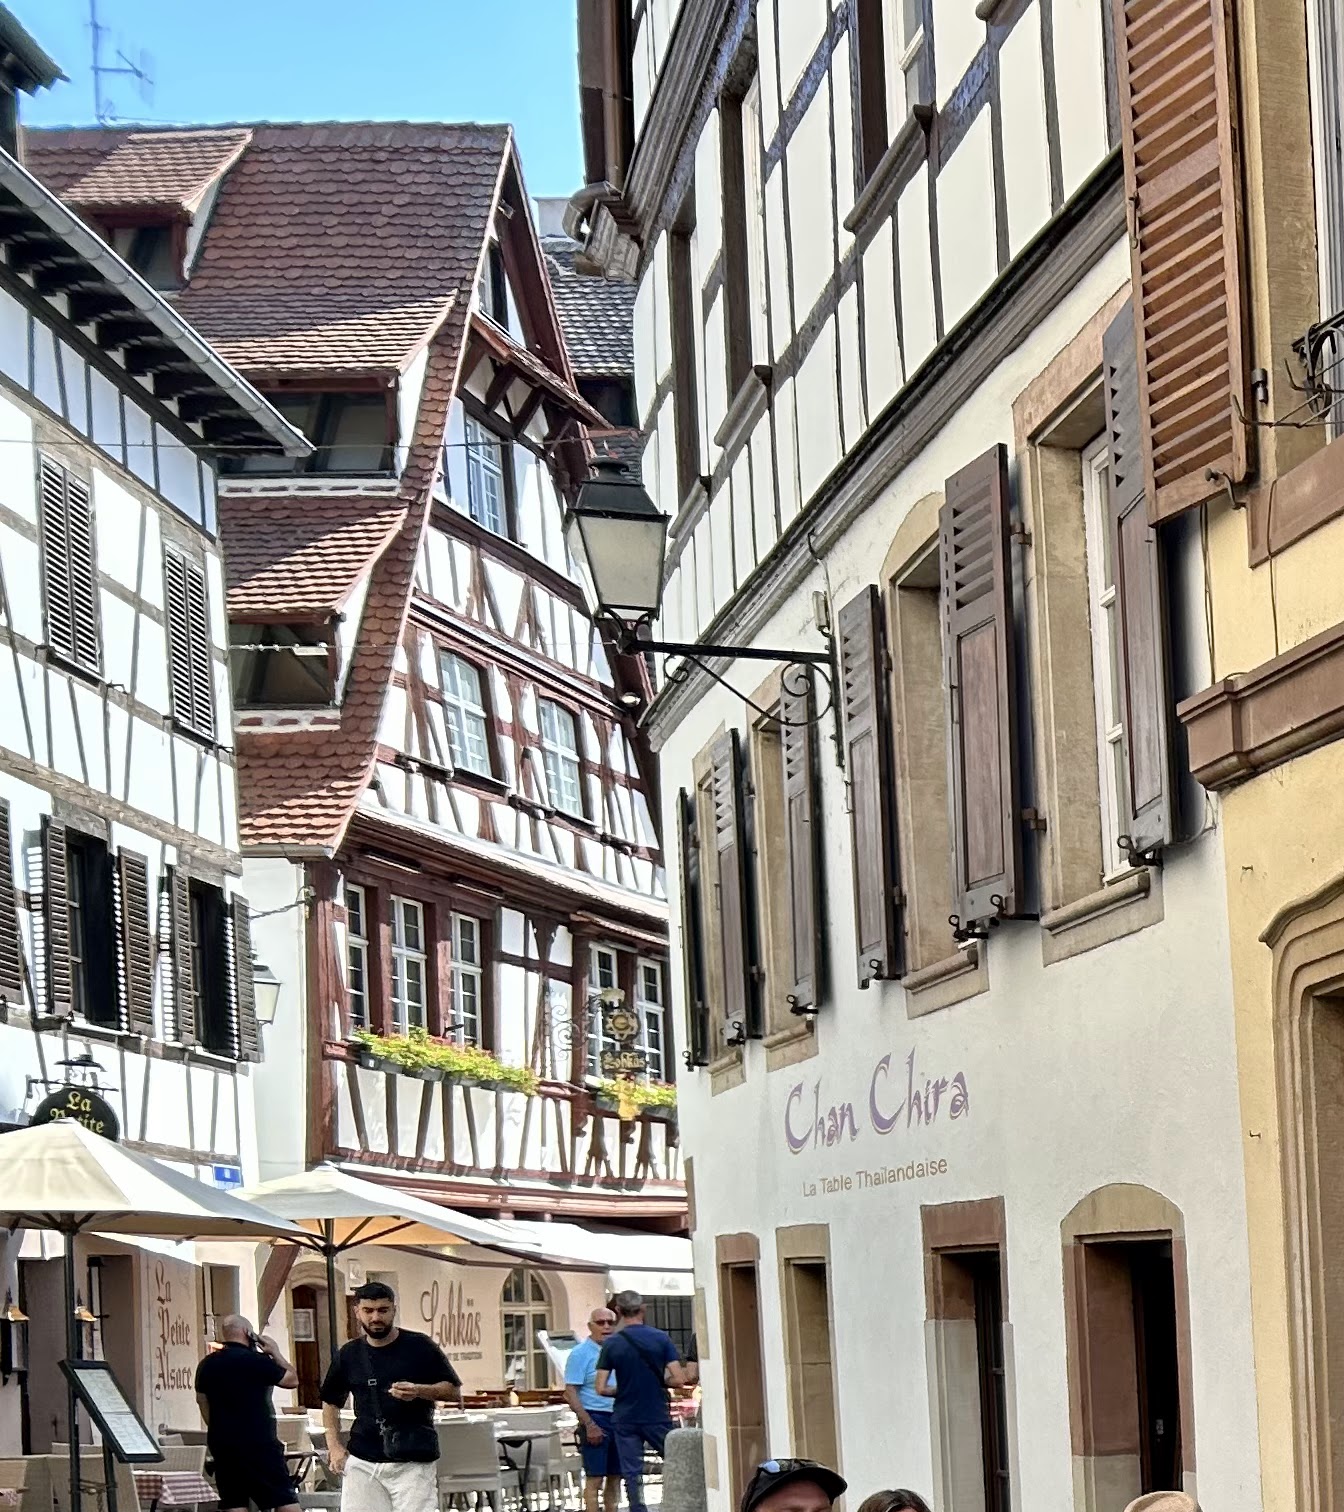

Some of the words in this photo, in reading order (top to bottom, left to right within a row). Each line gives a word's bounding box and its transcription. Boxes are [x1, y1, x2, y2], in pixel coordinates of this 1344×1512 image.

[784, 1076, 860, 1155] Chan
[869, 1047, 969, 1135] Chira
[803, 1180, 817, 1197] La
[820, 1175, 852, 1195] Table
[155, 1260, 171, 1304] La
